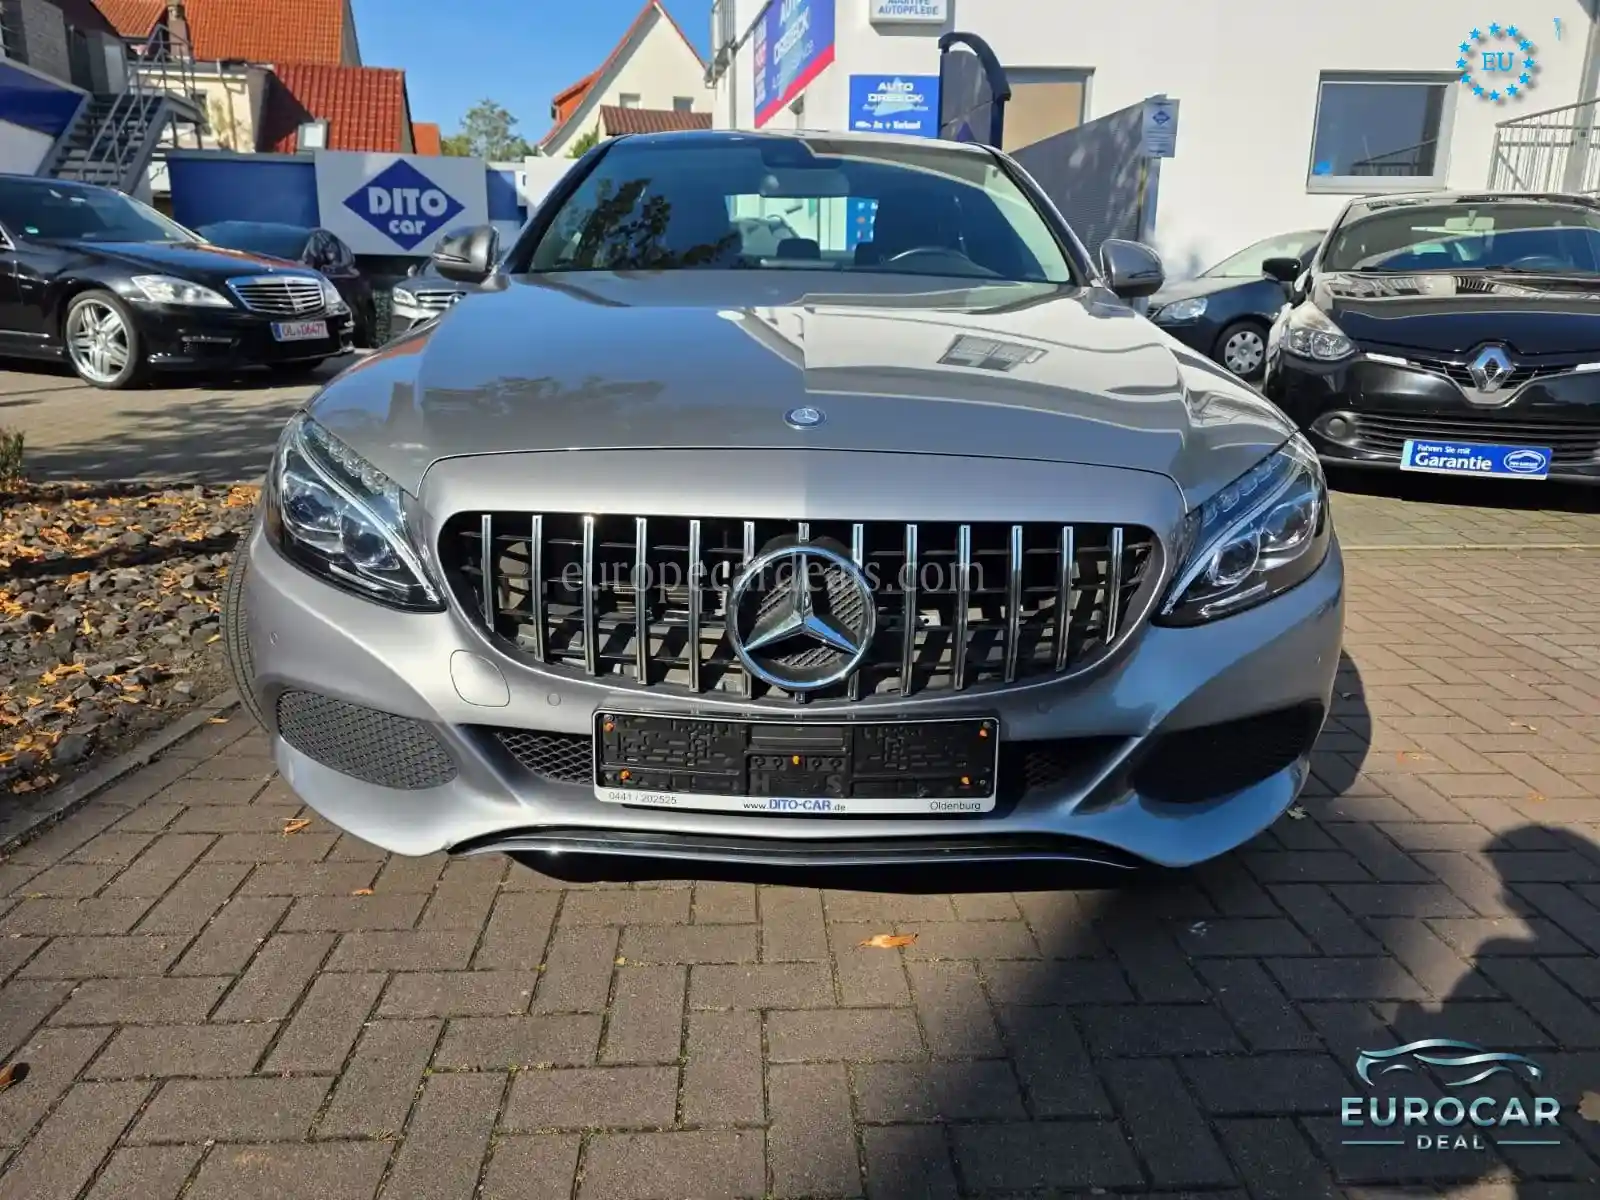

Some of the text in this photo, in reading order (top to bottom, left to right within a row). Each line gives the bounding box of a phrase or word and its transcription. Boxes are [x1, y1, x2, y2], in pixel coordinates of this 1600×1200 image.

[877, 82, 914, 91] AUTO
[368, 186, 448, 217] DITO
[388, 219, 426, 235] car
[1417, 444, 1443, 453] Fahren
[1444, 445, 1456, 454] Sie
[1415, 452, 1493, 471] Garantie
[608, 791, 633, 801] 0441
[641, 794, 678, 805] 202525
[743, 799, 846, 811] www.DITO-CAR.de
[929, 800, 981, 811] Oldenburg
